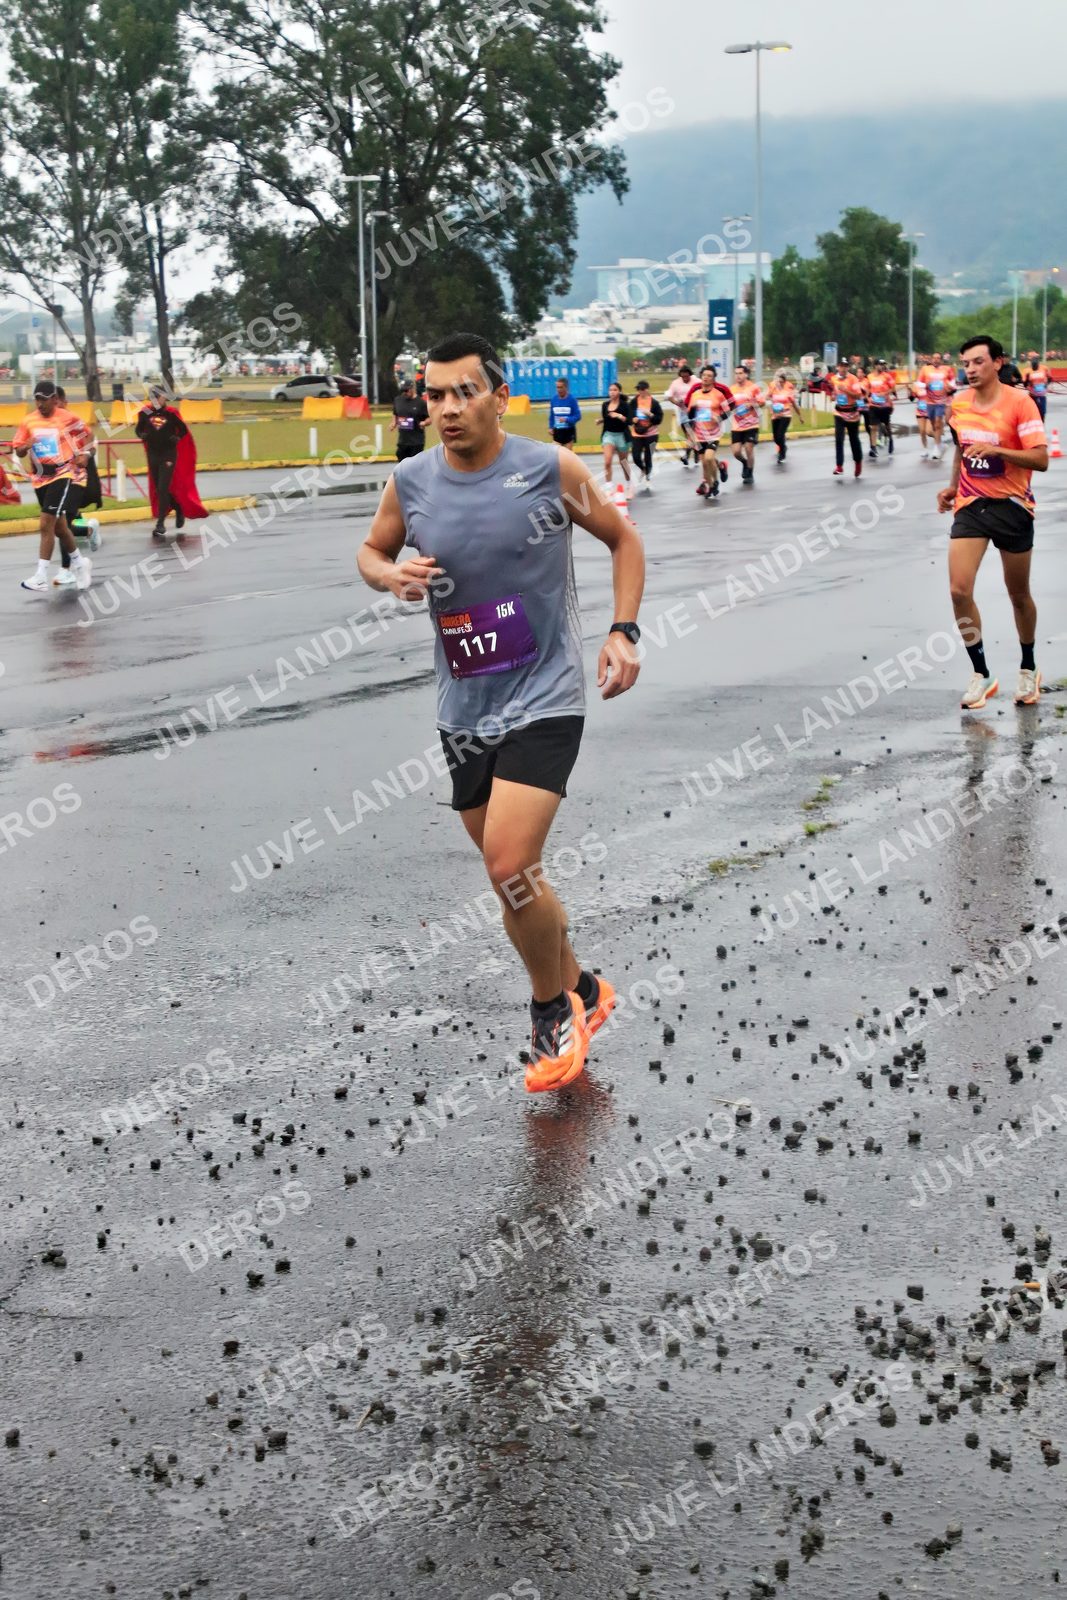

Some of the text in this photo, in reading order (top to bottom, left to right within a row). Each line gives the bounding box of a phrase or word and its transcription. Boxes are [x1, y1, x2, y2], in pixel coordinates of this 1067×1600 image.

[713, 316, 727, 335] E
[970, 458, 989, 469] 724
[459, 632, 497, 657] 117
